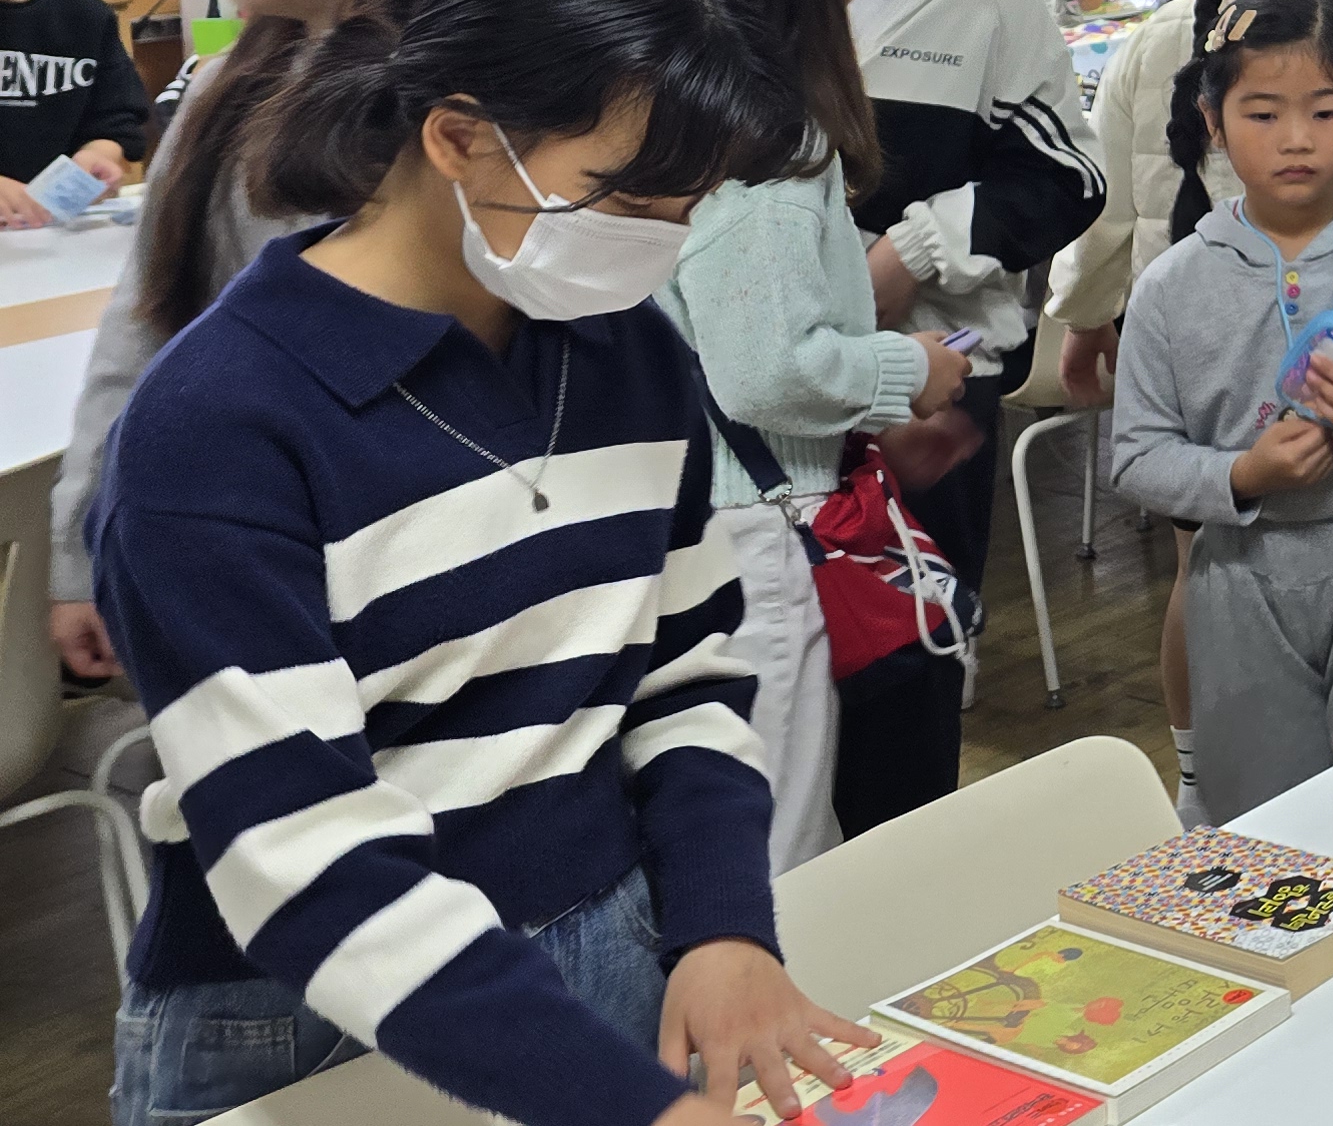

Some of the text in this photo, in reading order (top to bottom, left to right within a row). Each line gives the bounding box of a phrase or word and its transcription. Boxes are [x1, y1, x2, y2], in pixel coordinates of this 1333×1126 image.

[880, 45, 964, 68] EXPOSURE
[1112, 976, 1212, 1025] 때문에
[1117, 978, 1250, 1047] 사랑하기
